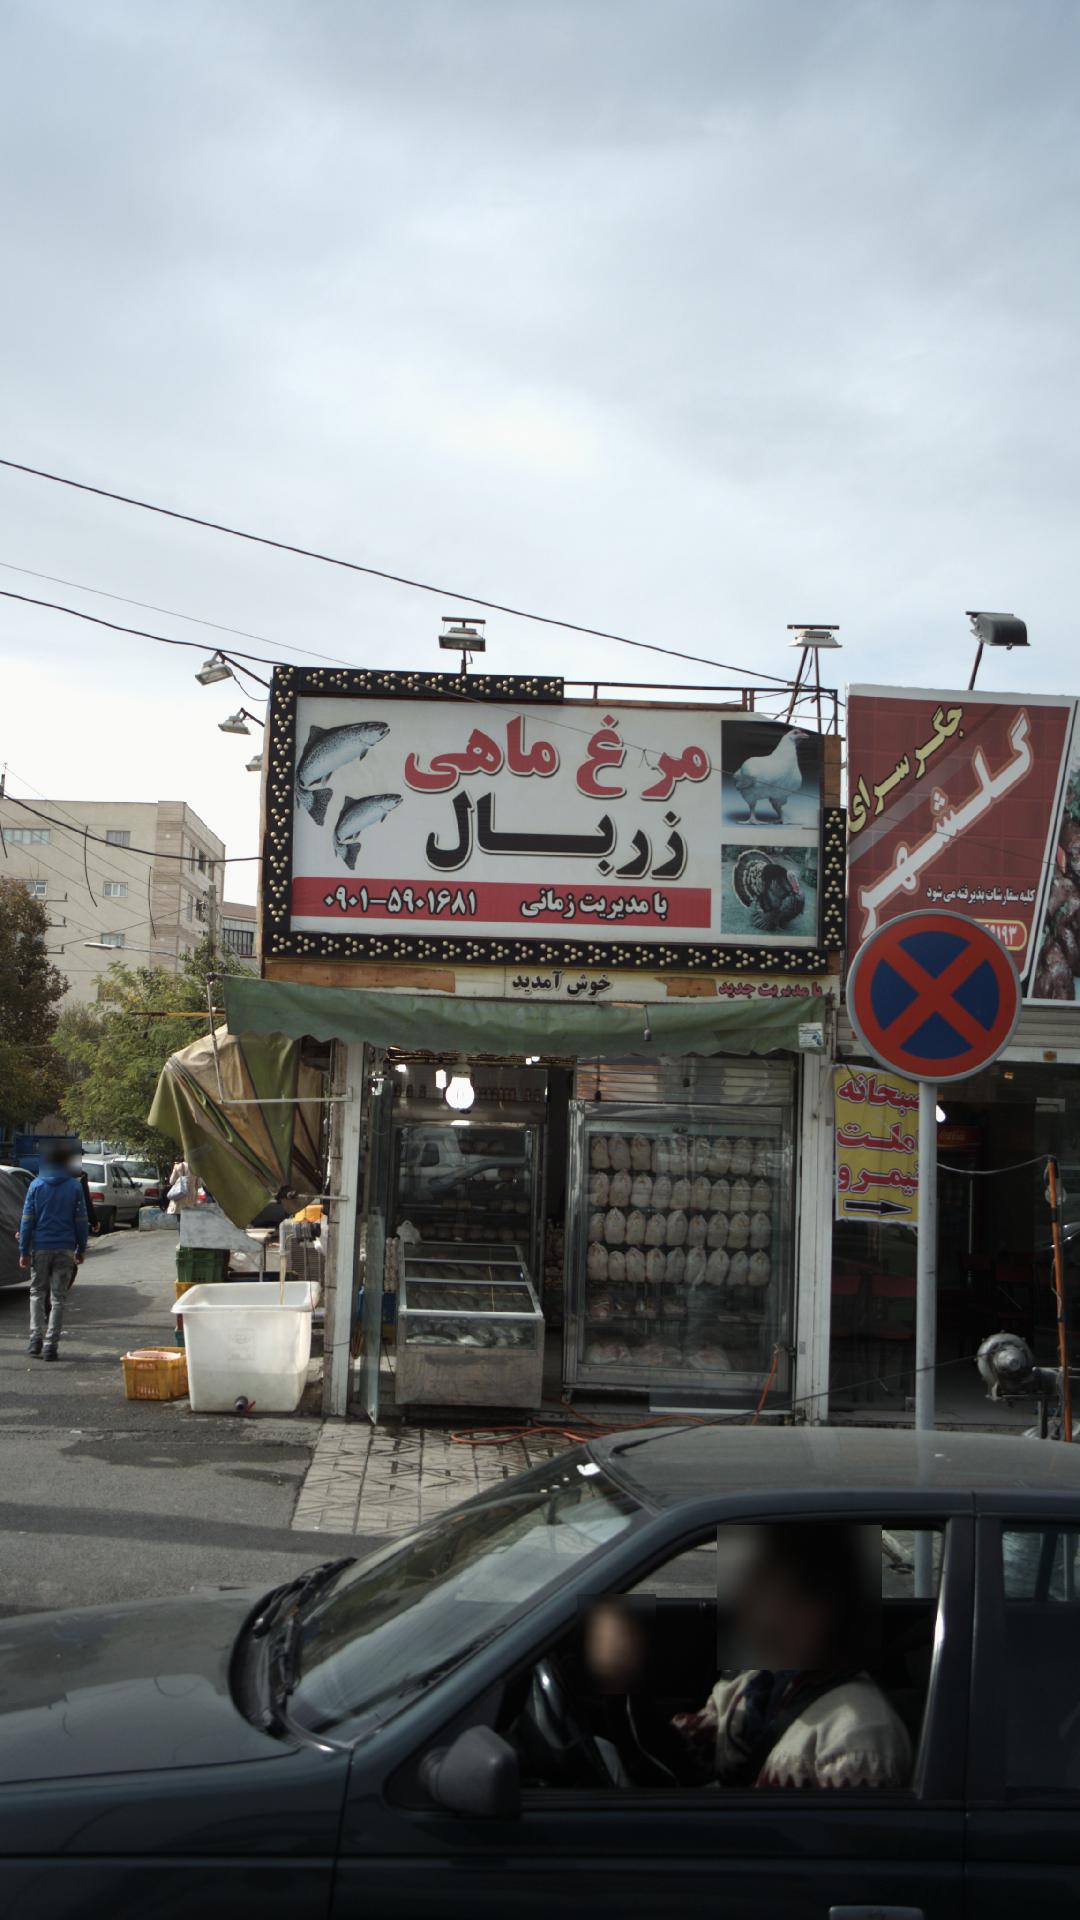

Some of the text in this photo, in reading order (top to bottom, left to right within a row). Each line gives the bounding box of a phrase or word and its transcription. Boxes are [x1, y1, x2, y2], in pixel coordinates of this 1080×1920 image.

[404, 714, 712, 800] مرغ ماهی
[425, 790, 688, 879] زربال
[859, 707, 1033, 940] گلشهر
[519, 888, 669, 920] با مدیریت زمانی
[926, 884, 943, 902] شود
[943, 889, 956, 902] می
[986, 886, 1020, 906] سفارشات
[1020, 888, 1036, 906] کلیه
[512, 970, 613, 996] خوش آمدید
[718, 981, 757, 999] جدید
